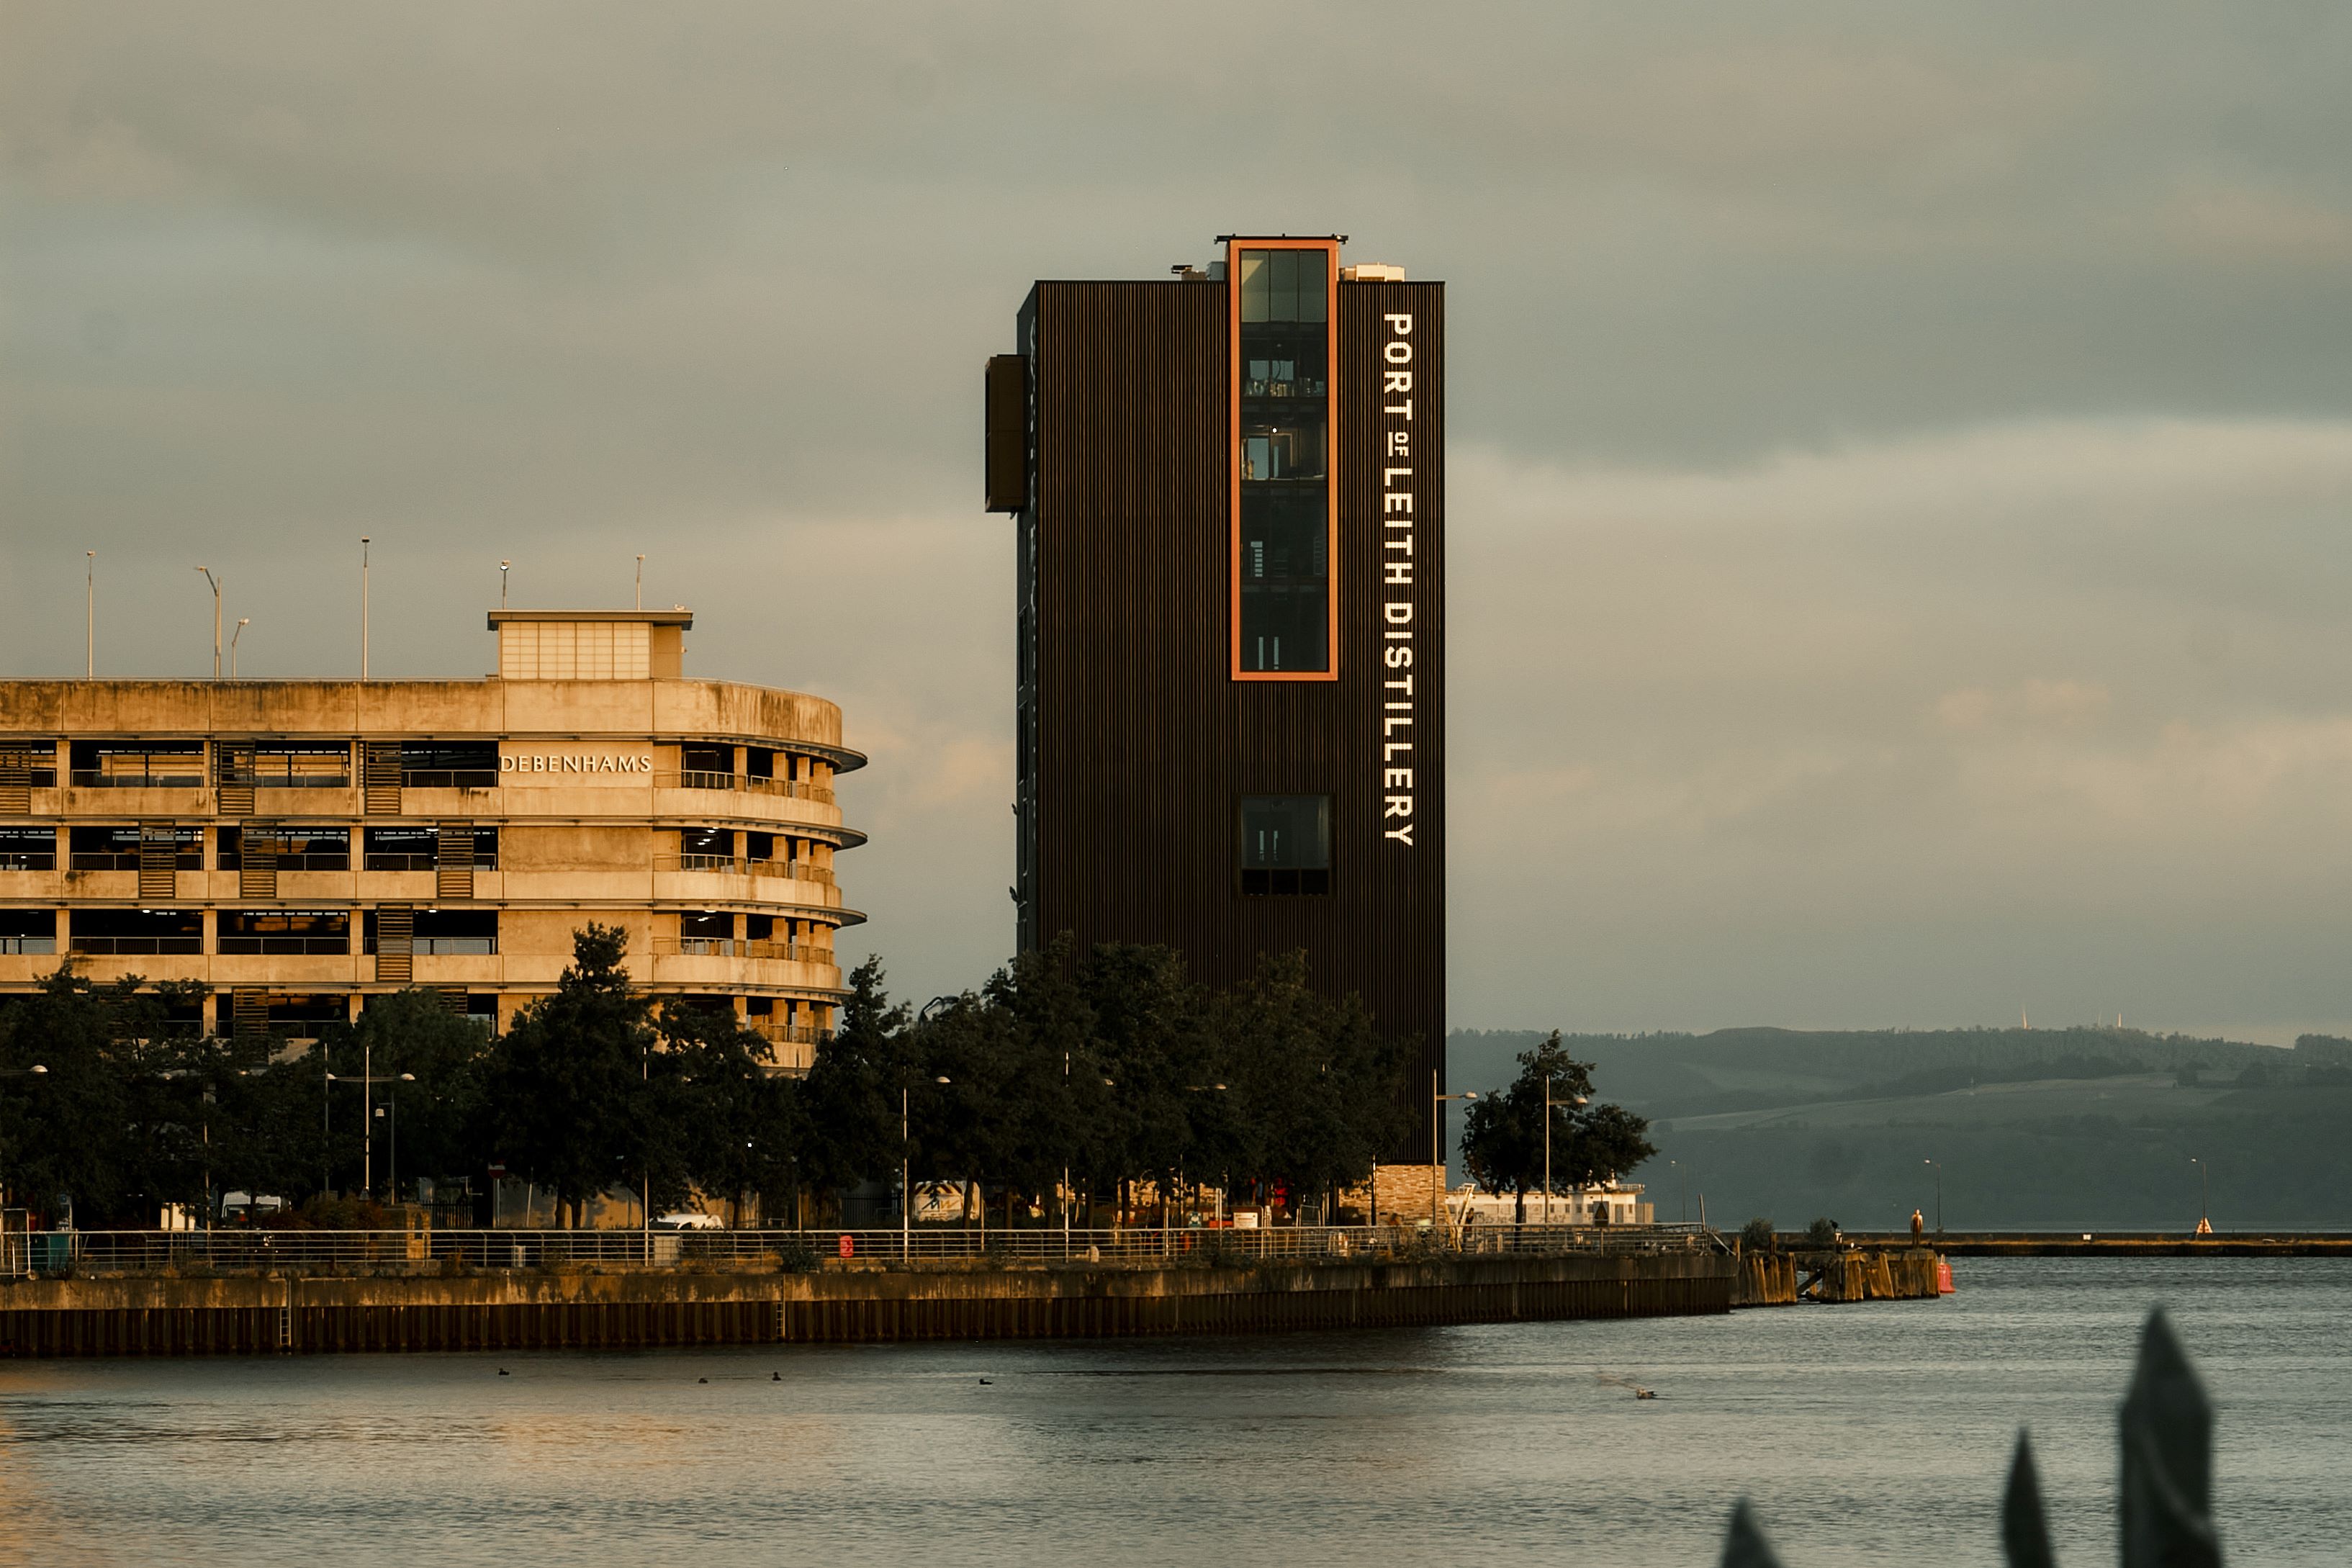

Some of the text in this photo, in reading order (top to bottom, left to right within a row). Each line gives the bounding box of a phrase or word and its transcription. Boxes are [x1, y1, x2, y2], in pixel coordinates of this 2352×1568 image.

[1384, 313, 1413, 846] PORT OF LEITH DISTILLERY
[500, 754, 652, 772] DEBENHAMS
